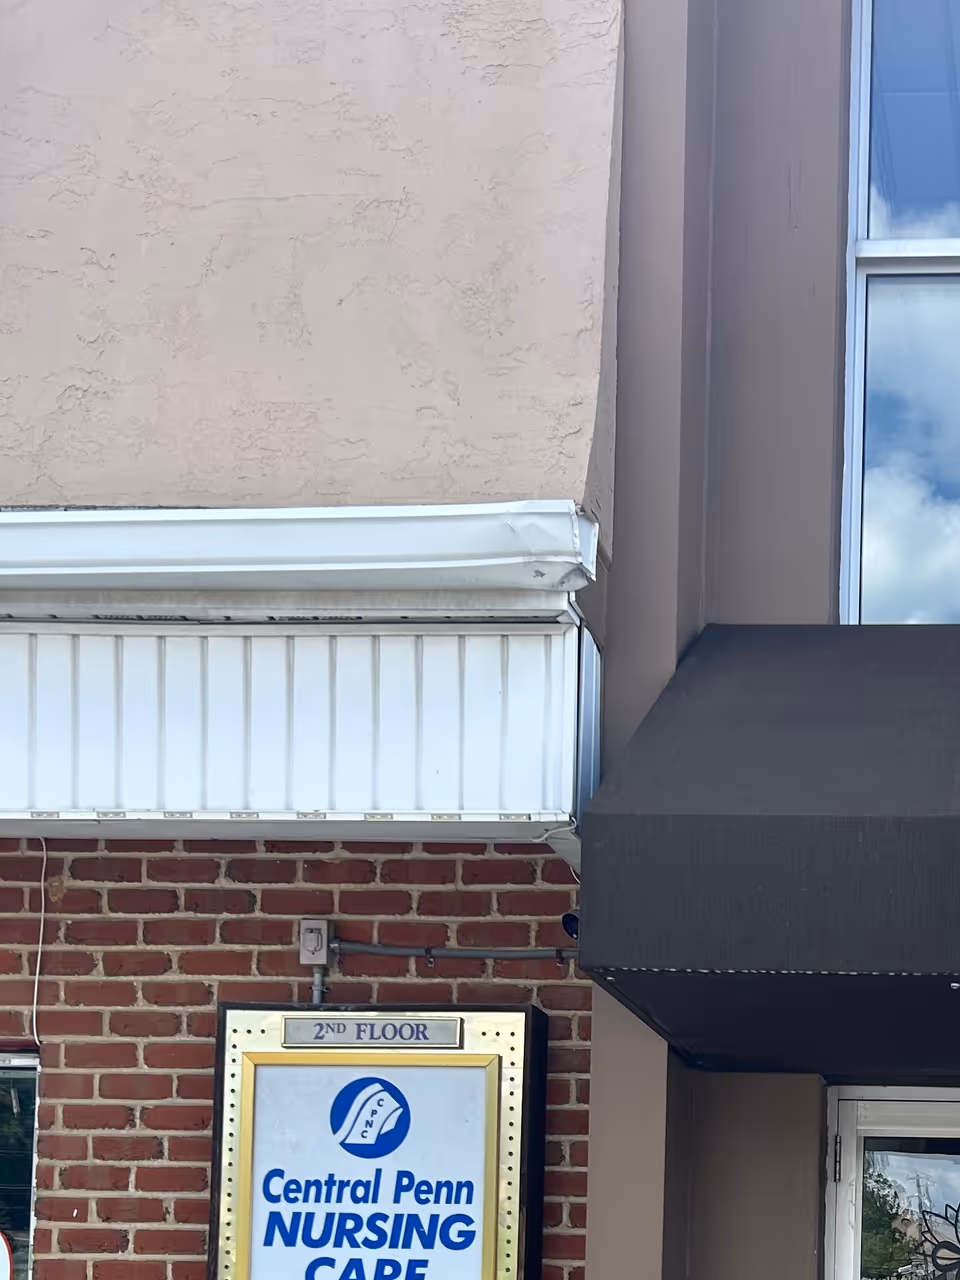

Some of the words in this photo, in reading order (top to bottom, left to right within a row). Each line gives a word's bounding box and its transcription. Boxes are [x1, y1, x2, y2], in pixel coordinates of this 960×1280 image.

[313, 1022, 347, 1041] 2ND
[355, 1023, 429, 1042] FLOOR
[262, 1168, 382, 1204] Central
[393, 1170, 474, 1205] Penn
[263, 1211, 477, 1250] NURSING
